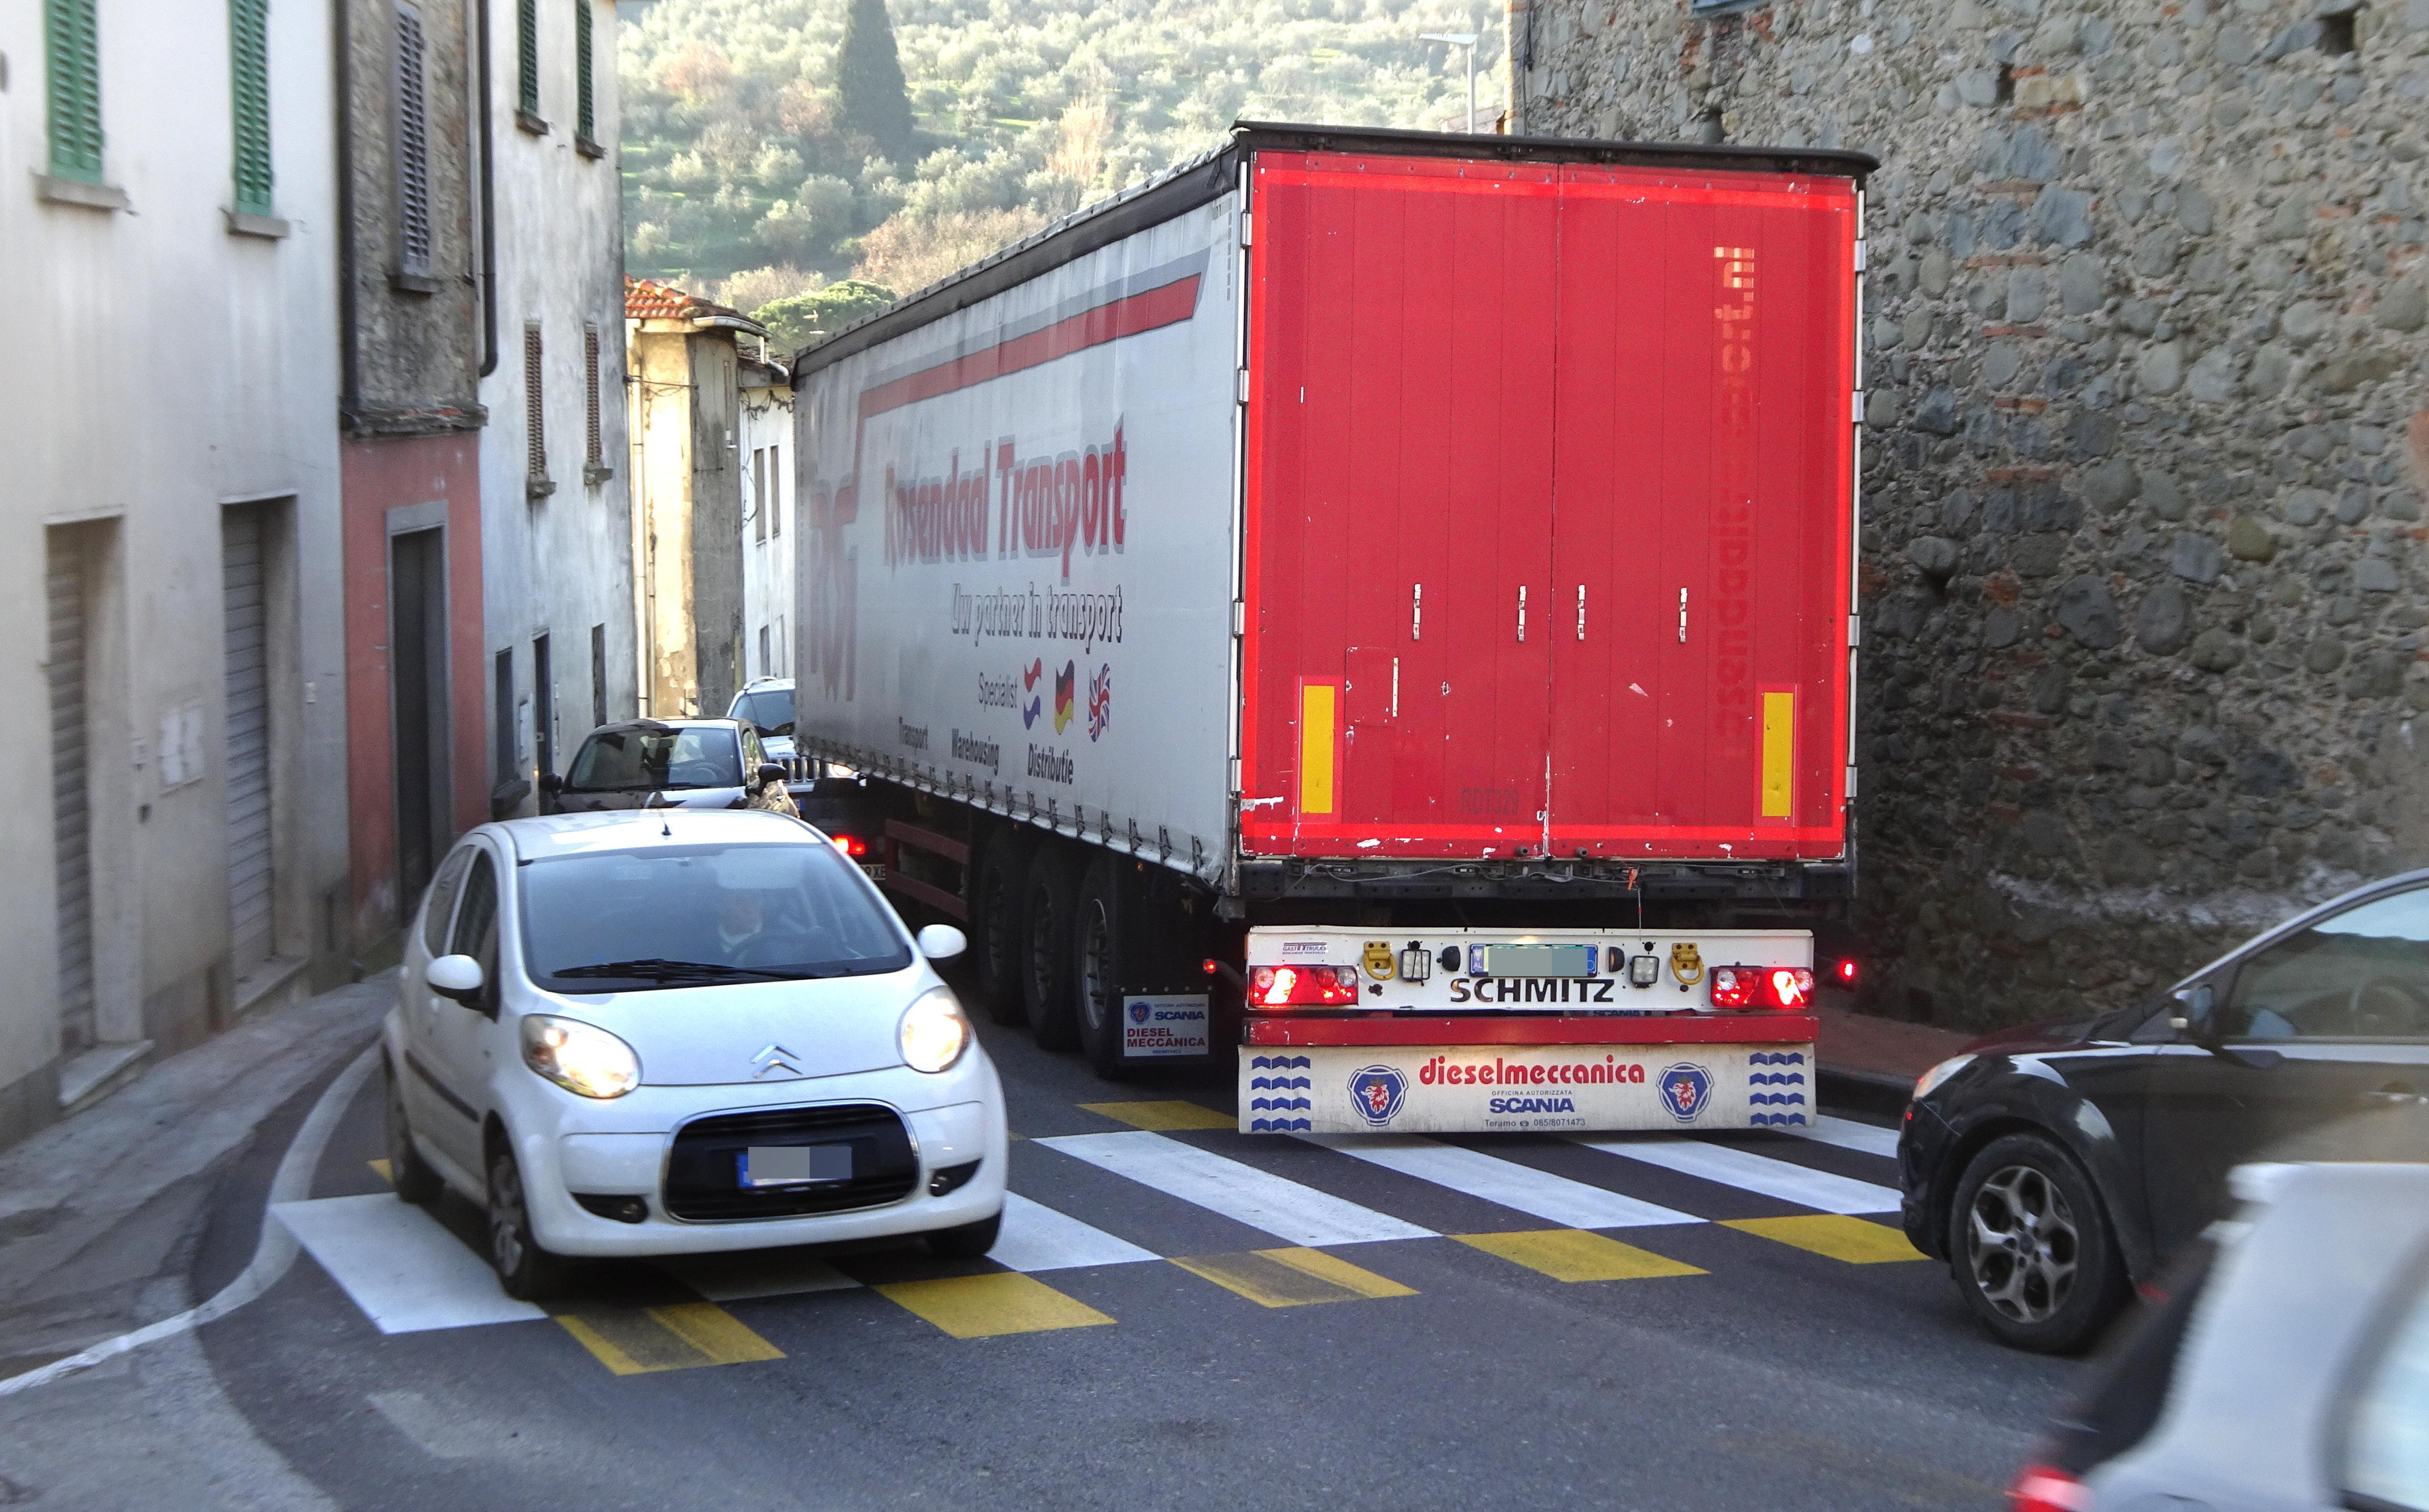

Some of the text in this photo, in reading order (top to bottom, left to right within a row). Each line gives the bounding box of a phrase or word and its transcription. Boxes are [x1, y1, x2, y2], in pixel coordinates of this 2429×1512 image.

[885, 413, 1127, 586] Rosendaal Transport
[974, 586, 1025, 646] partner
[1028, 581, 1041, 638] in
[1047, 584, 1122, 654] transport
[978, 671, 1017, 712] Specialist
[952, 728, 1000, 776] Warehousing
[1027, 743, 1074, 785] Distributie
[1451, 978, 1615, 1003] SCHMITZ
[1154, 1011, 1205, 1020] SCANIA
[1127, 1028, 1174, 1037] DIESEL
[1127, 1037, 1206, 1048] MECCANICA
[1419, 1054, 1645, 1085] dieselmeccanica
[1489, 1098, 1575, 1113] SCANIA
